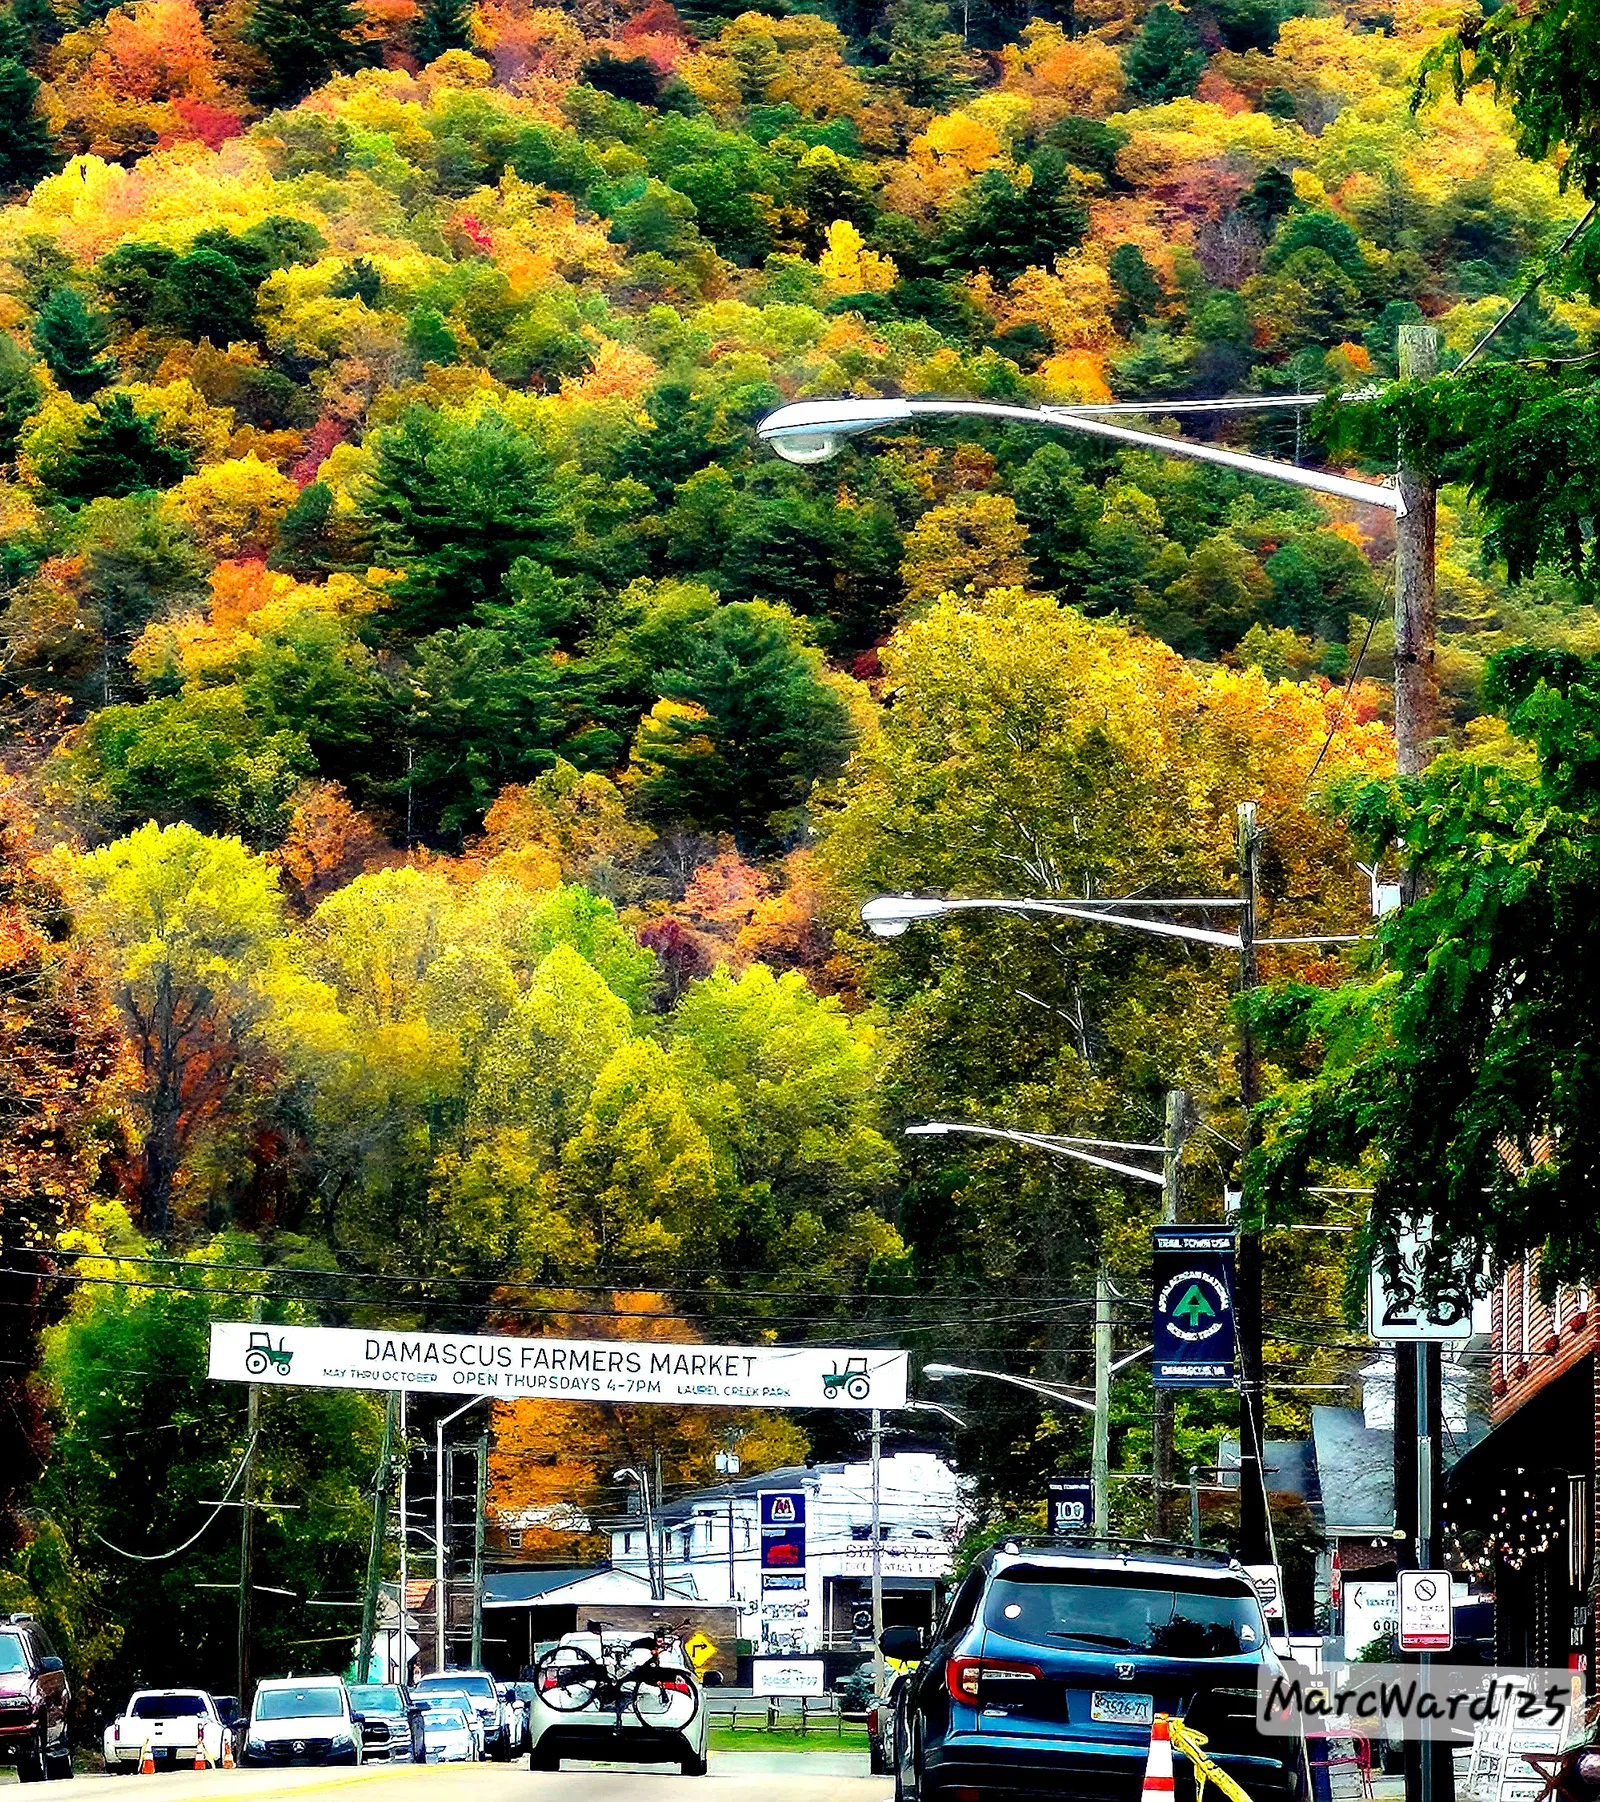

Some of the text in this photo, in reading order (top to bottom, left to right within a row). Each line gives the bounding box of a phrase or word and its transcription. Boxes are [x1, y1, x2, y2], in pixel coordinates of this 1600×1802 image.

[365, 1339, 757, 1377] DAMASCUS FARMERS MARKET
[322, 1368, 438, 1383] MAY THRU OCTOBER
[452, 1371, 662, 1394] OPEN THURSDAYS 4-7PM
[677, 1385, 720, 1396] LAUREL
[762, 1386, 792, 1397] PARK
